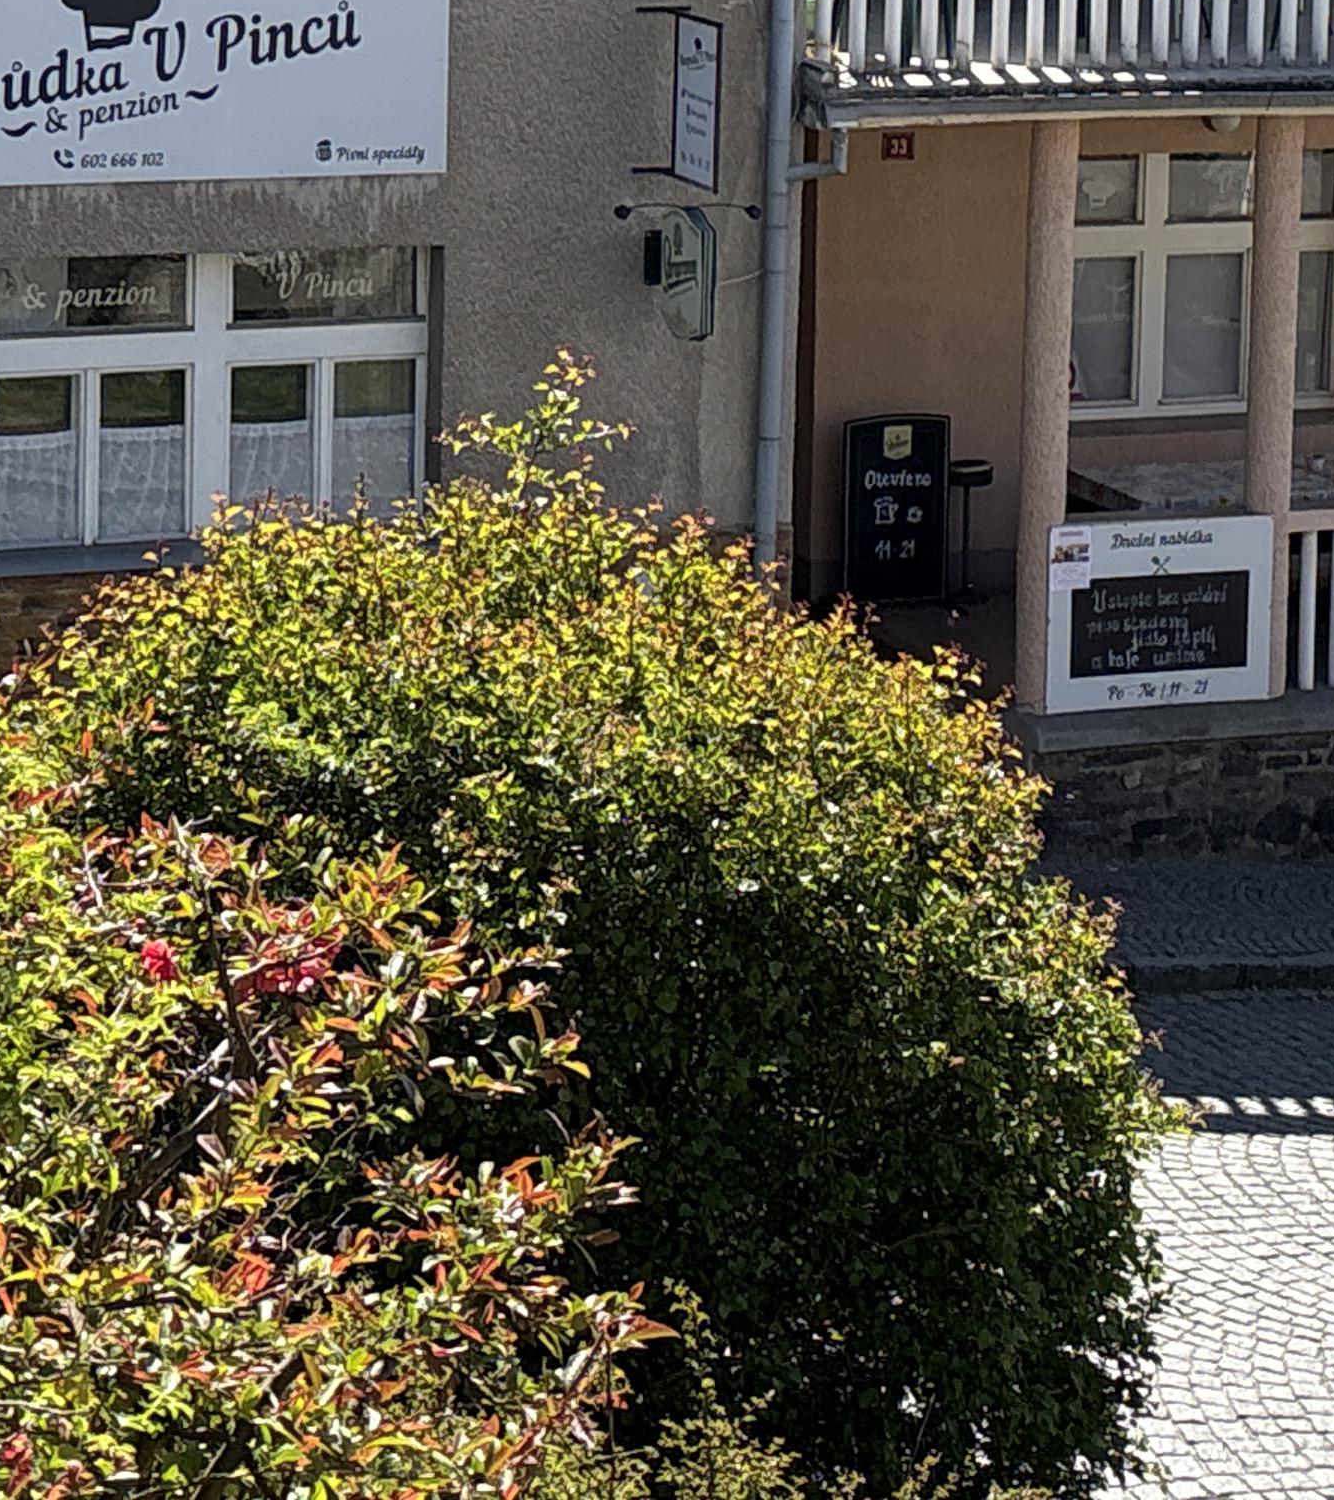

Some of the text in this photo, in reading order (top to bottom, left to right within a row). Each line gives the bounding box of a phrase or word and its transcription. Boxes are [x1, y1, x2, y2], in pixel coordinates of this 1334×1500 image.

[142, 20, 186, 82] V
[205, 0, 362, 72] Pinců
[44, 91, 180, 142] & penzion
[80, 151, 165, 168] 602 666 102
[336, 144, 425, 166] Pivní speciály
[890, 137, 908, 155] 33
[21, 279, 157, 321] & penzion
